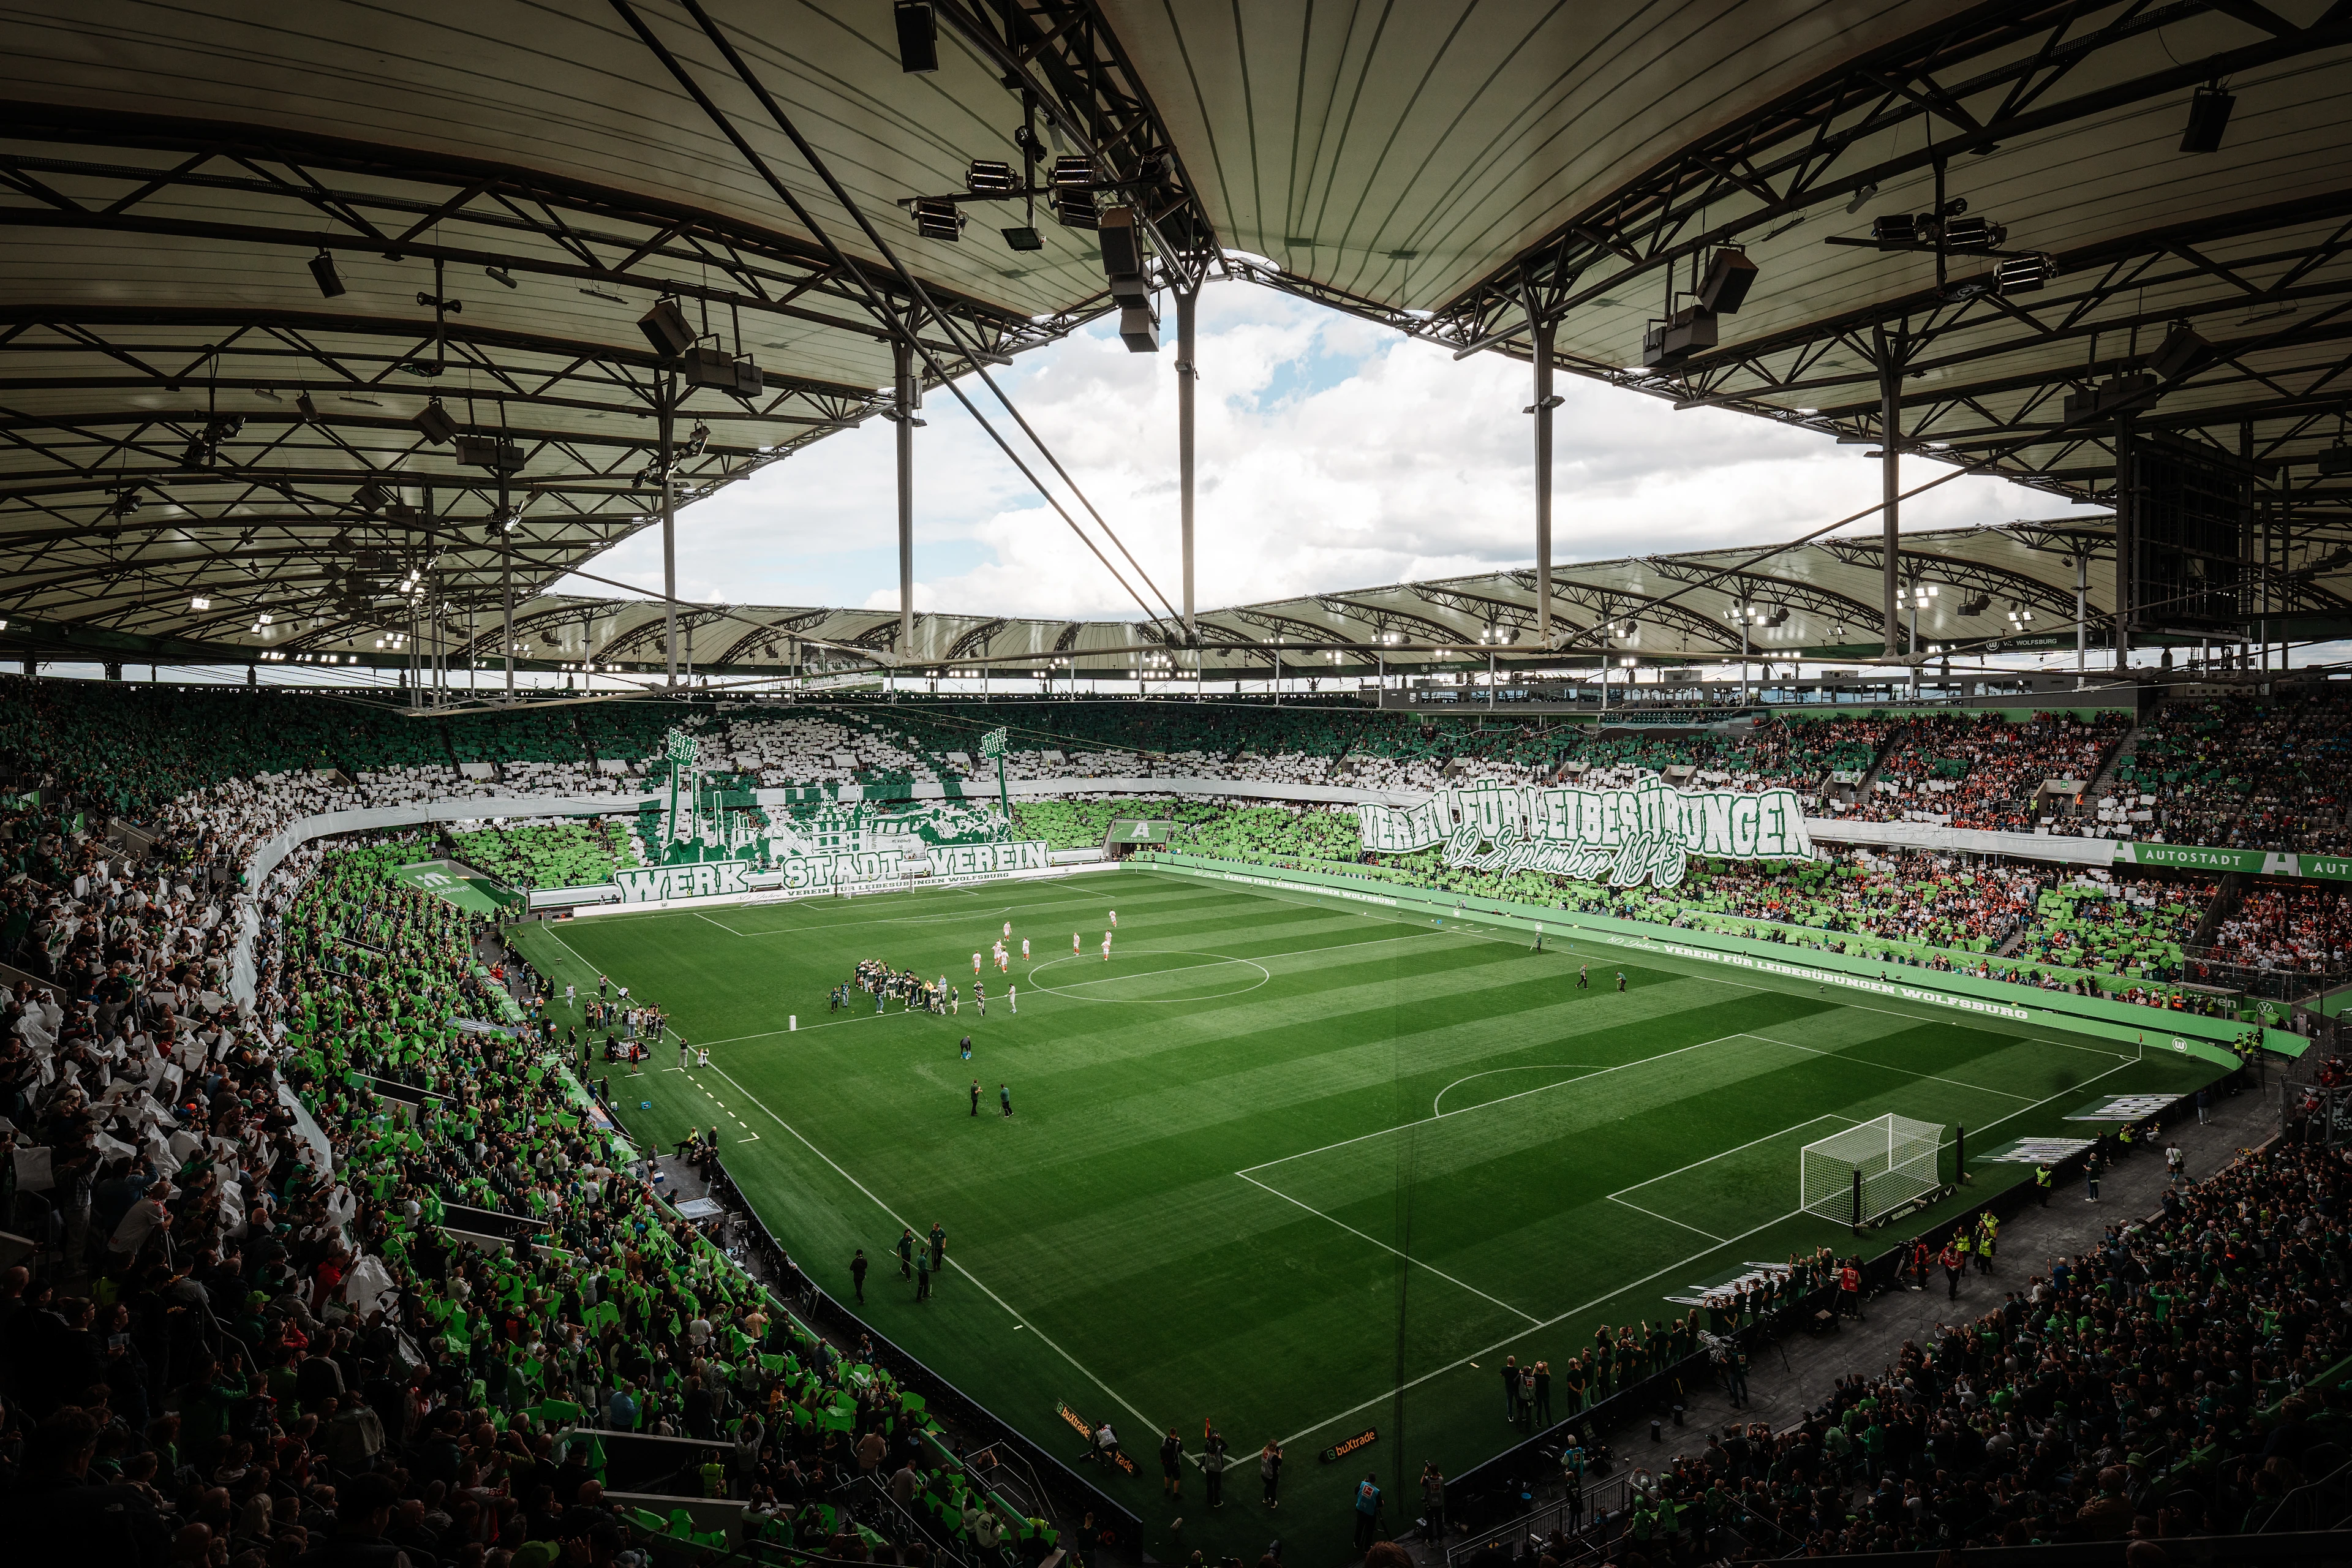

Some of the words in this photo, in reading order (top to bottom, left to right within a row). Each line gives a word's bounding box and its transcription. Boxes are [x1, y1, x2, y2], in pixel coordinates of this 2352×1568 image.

[1359, 790, 1451, 850] VEREIN
[1459, 777, 1523, 839] FÜR
[1526, 775, 1814, 859] LEIBESÜBUNGEN
[1479, 825, 1612, 878] September
[1613, 831, 1686, 888] 1945
[2146, 850, 2241, 866] AUTOSTADT
[616, 862, 748, 903] WERK
[783, 850, 903, 889] STADT
[927, 842, 1048, 876] VEREIN
[859, 878, 945, 891] LEIBESÜBUNGEN
[948, 873, 1009, 883] WOLFSBURG
[1224, 874, 1252, 883] VEREIN
[1271, 880, 1340, 896] LEIBESÜBUNGEN
[1343, 891, 1397, 905] WOLFSBURG
[1607, 936, 1624, 946] 80
[1625, 940, 1659, 951] Jahre
[1664, 945, 1719, 961] VEREIN
[1724, 954, 1753, 967] FÜR
[1757, 961, 1895, 993] LEIBESÜBUNGEN
[1900, 987, 2028, 1020] WOLFSBURG
[1061, 1407, 1091, 1438] buXtrade
[1335, 1431, 1375, 1457] buXtrade
